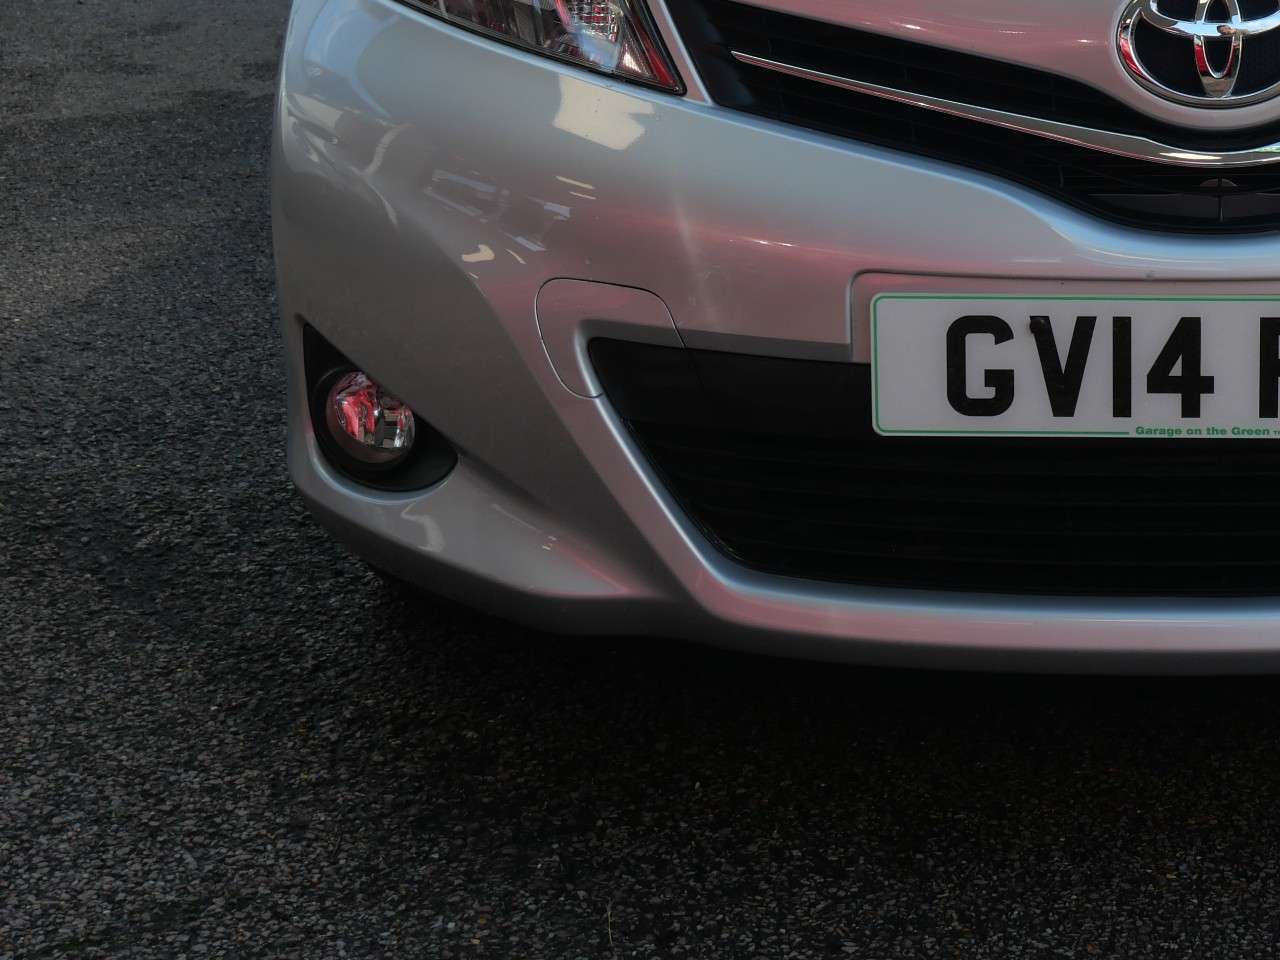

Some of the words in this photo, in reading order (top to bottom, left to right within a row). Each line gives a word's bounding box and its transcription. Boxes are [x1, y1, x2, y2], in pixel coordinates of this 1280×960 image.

[945, 314, 1215, 419] GV14
[1135, 426, 1183, 438] Garage
[1185, 428, 1202, 436] on
[1206, 426, 1228, 436] the
[1231, 426, 1271, 436] Green
